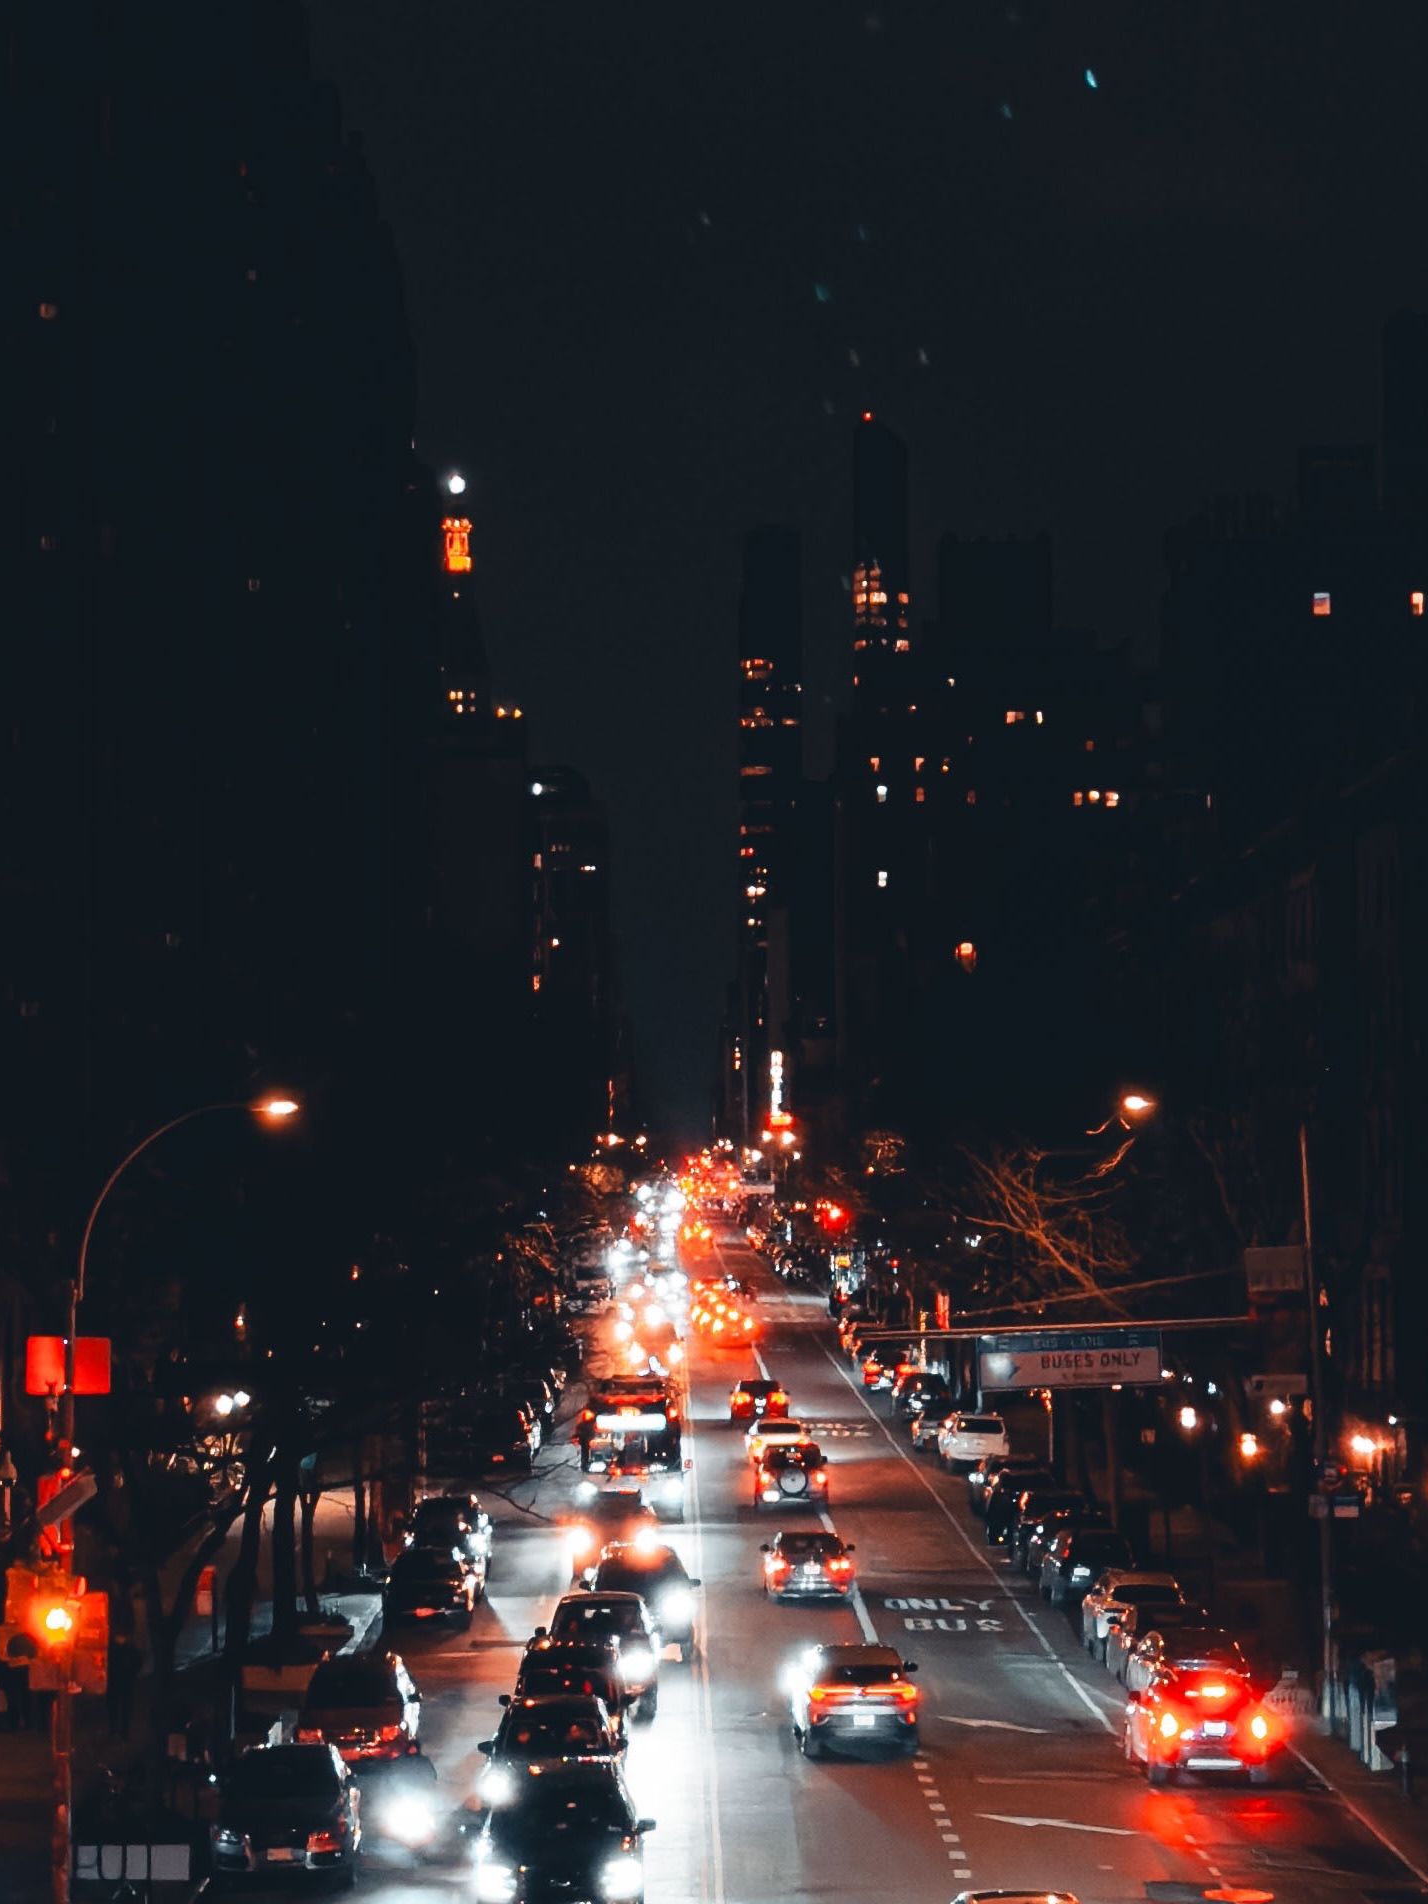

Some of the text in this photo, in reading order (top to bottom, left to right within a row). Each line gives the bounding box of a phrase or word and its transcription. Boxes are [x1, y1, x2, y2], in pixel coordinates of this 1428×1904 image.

[1040, 1351, 1141, 1370] BUSES ONLY
[883, 1597, 996, 1611] ONLY
[903, 1617, 1005, 1632] BUS
